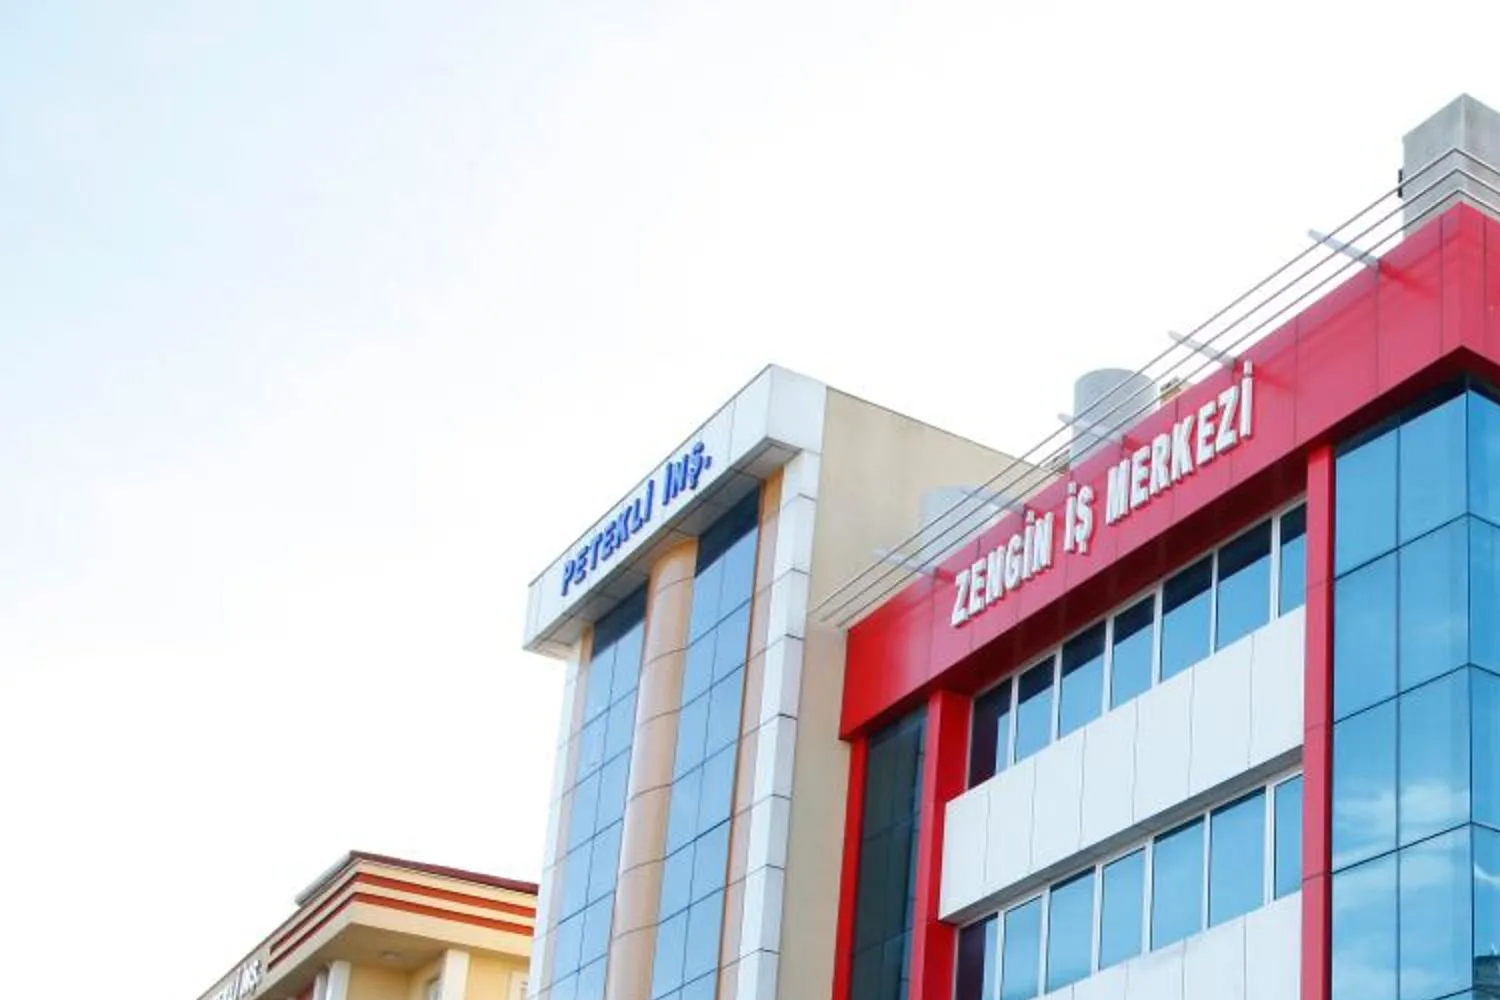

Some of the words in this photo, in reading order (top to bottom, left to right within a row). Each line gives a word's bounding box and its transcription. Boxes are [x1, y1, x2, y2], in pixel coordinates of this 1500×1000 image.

[950, 508, 1055, 629] ZENGİN
[1063, 481, 1093, 555] İŞ
[1105, 360, 1253, 526] MERKEZİ
